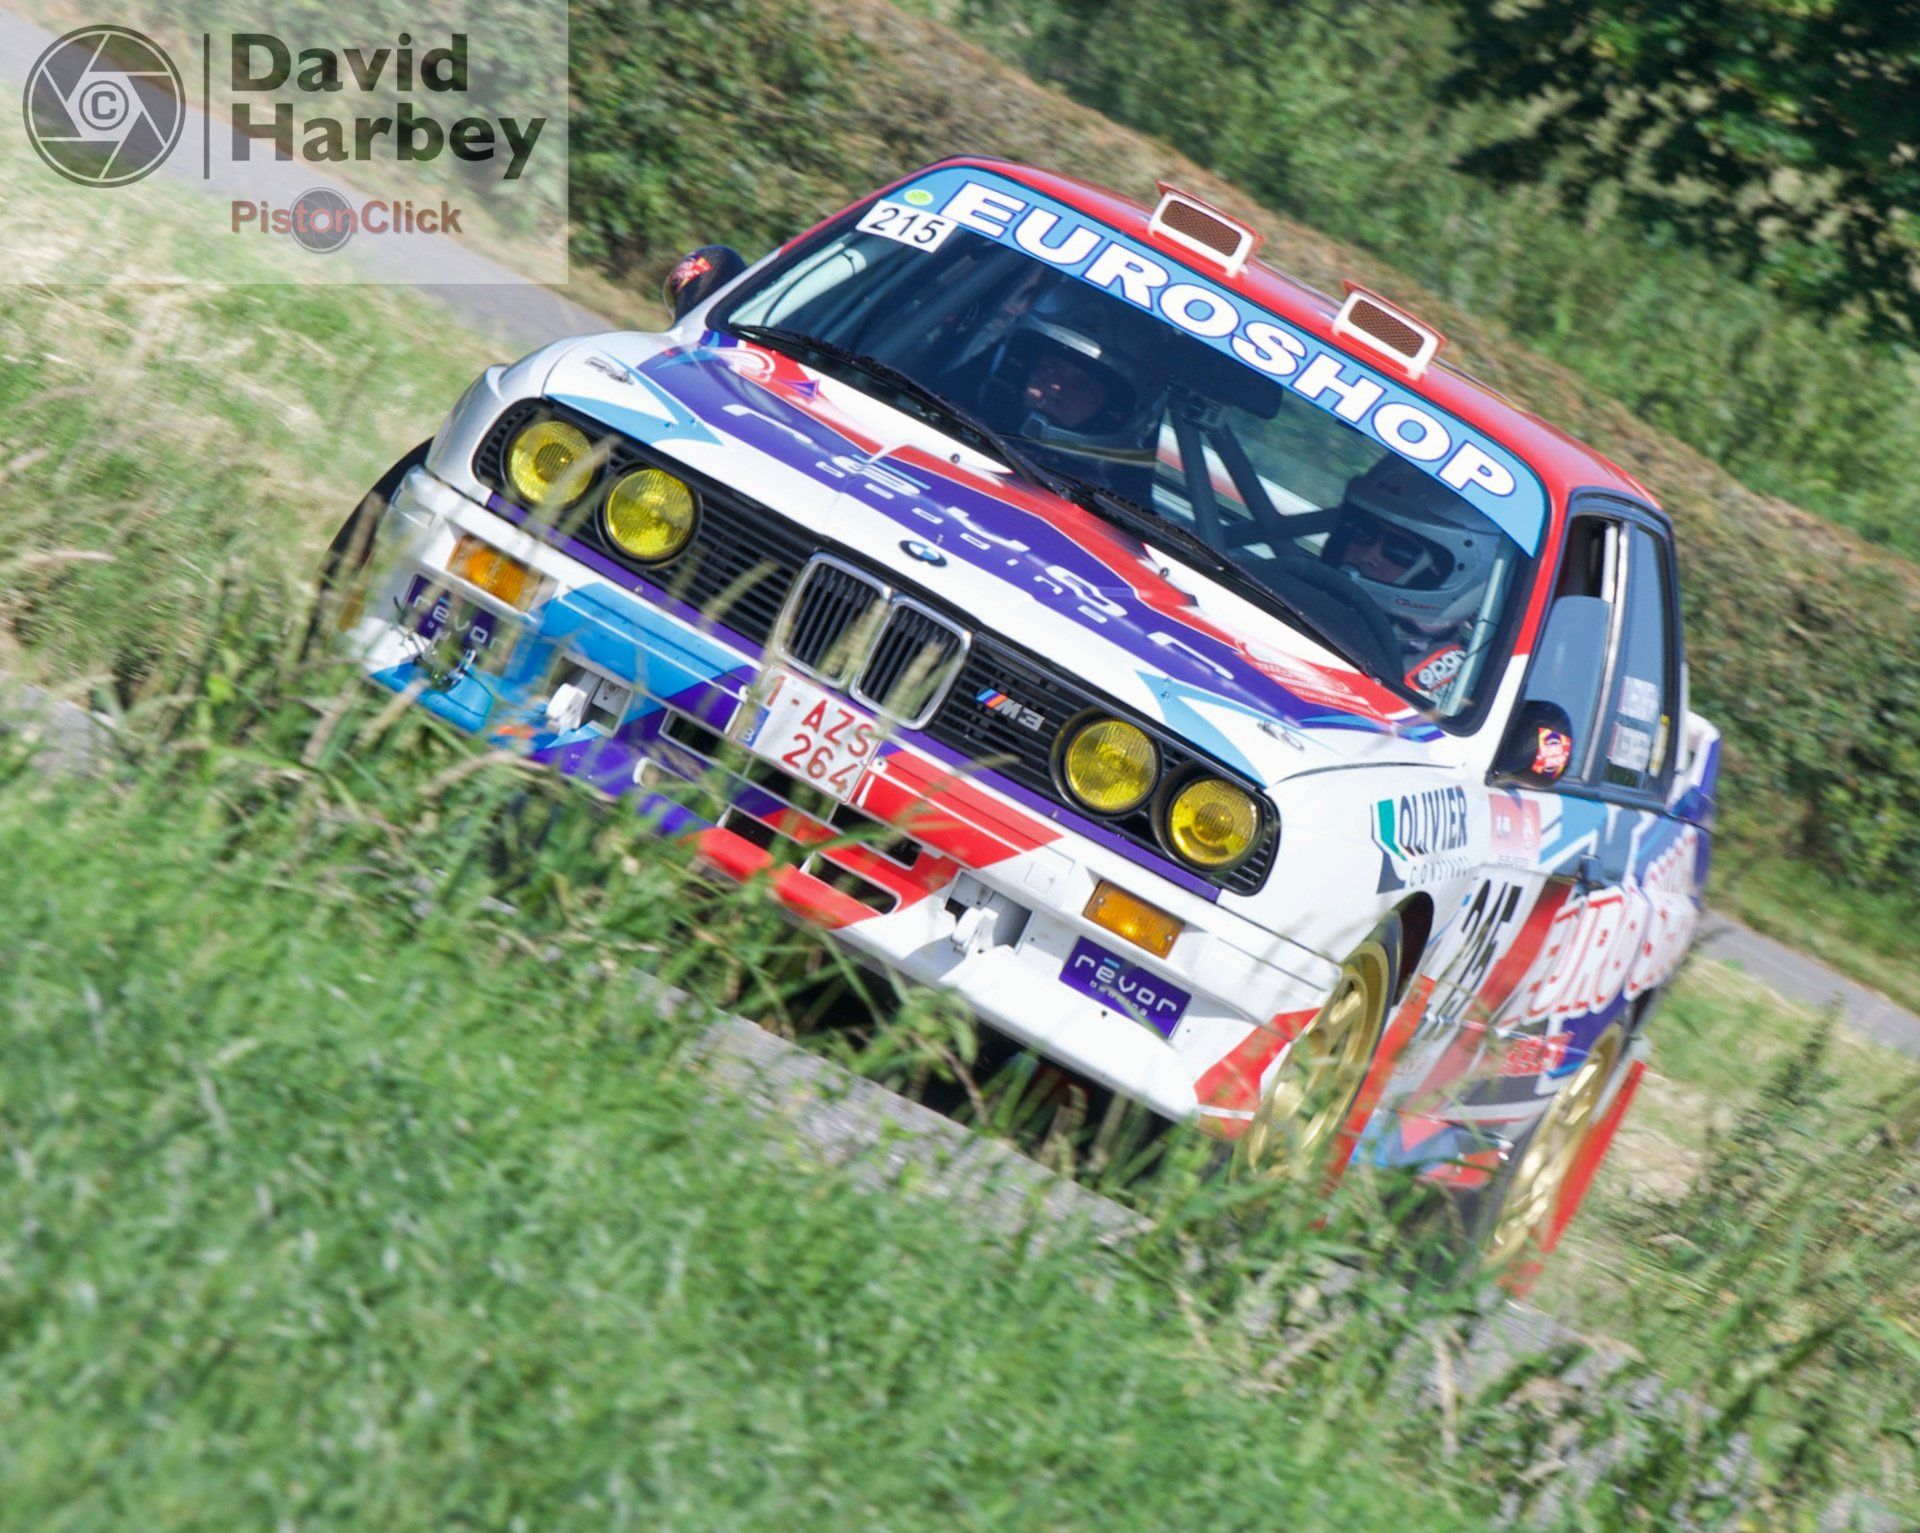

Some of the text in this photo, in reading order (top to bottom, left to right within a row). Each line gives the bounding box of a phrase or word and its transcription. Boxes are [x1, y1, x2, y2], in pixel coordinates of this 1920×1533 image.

[868, 207, 945, 243] 215
[939, 180, 1516, 498] EUROSHOP
[993, 698, 1045, 732] M3
[782, 733, 858, 793] 264
[1400, 785, 1467, 856] OLIVIER
